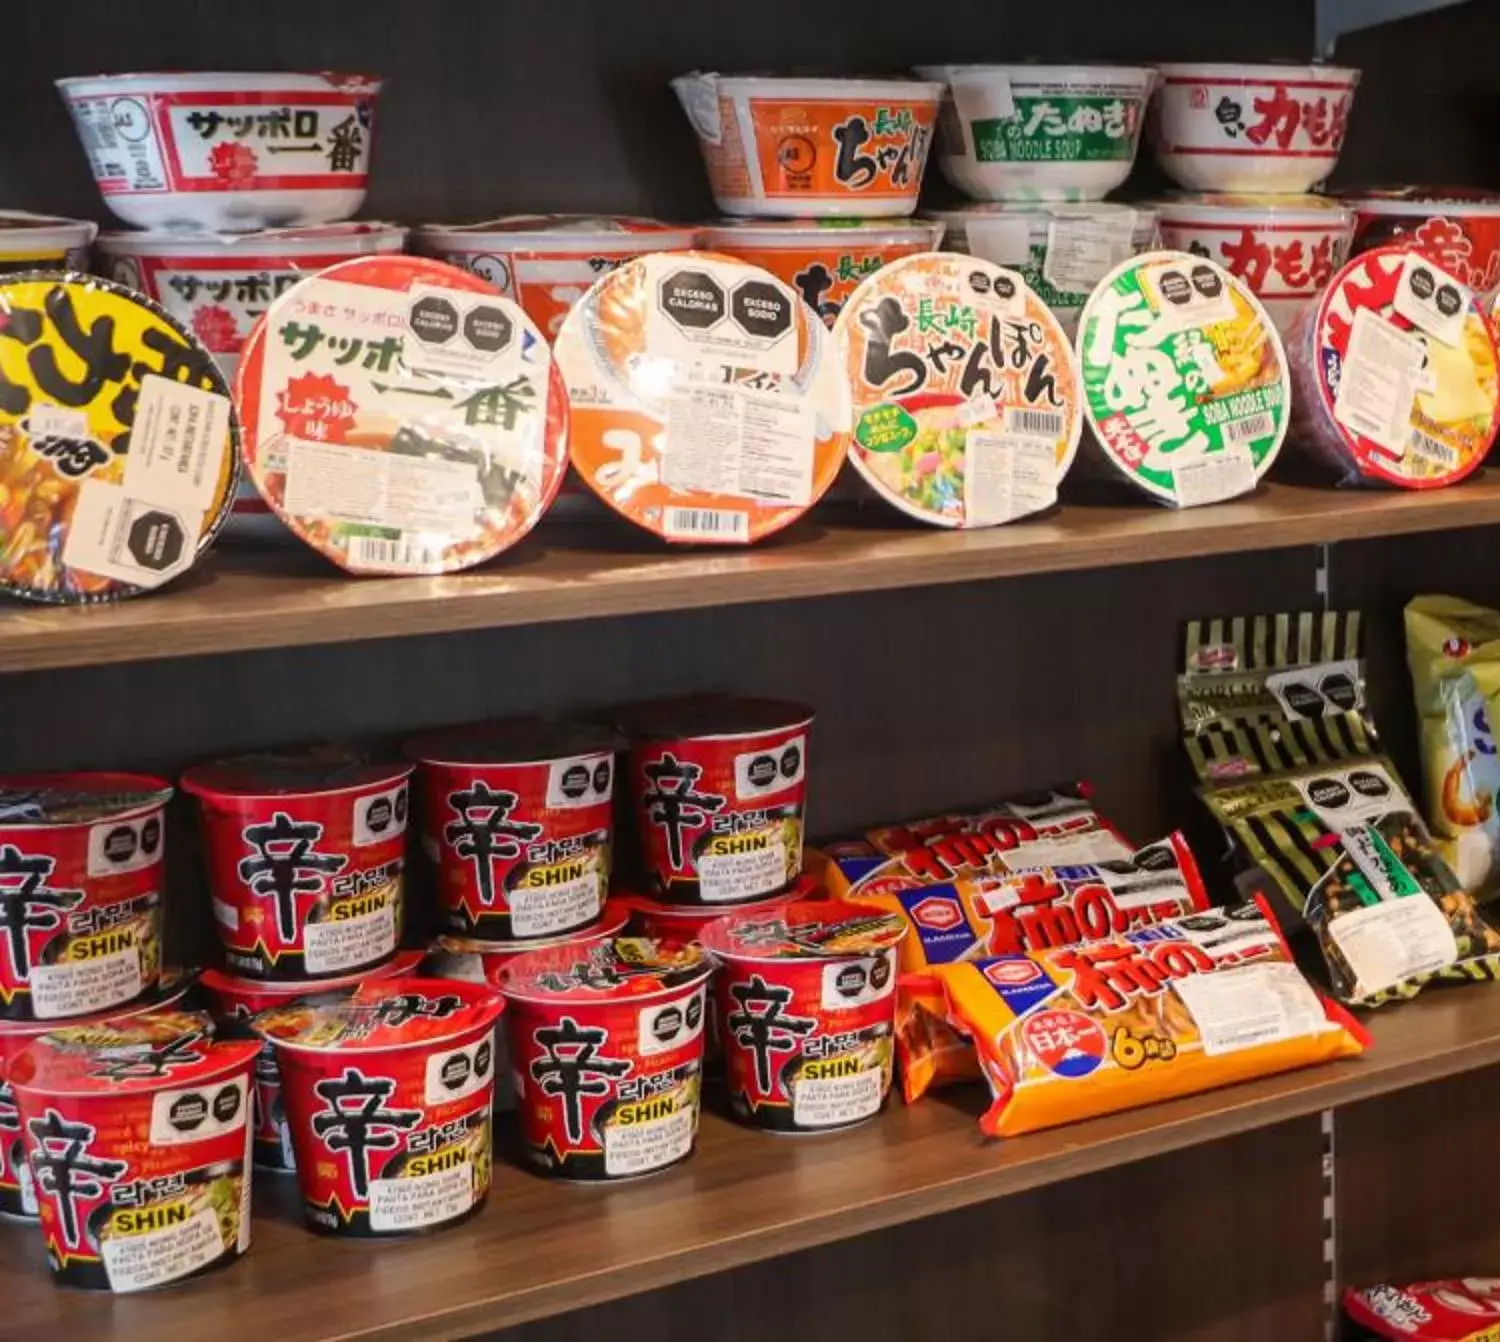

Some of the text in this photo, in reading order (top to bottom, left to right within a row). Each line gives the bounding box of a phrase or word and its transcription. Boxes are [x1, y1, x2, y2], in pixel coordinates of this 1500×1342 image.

[186, 108, 319, 140] サッポロ
[873, 107, 913, 135] 長崎
[1003, 100, 1126, 139] のたぬき
[266, 116, 362, 172] 一番
[1009, 138, 1053, 161] NOODLE
[1054, 137, 1083, 159] SOUP
[674, 287, 715, 301] EXCESO
[744, 297, 781, 312] EXCESO
[747, 307, 777, 321] SODIO
[915, 298, 980, 339] 長崎
[280, 320, 408, 373] サッポ
[859, 297, 1064, 408] ちゃんぽん
[282, 392, 354, 419] しょうゆ
[1202, 400, 1230, 425] SOBA
[642, 751, 727, 872] 辛
[443, 779, 544, 906] 辛
[715, 835, 768, 856] SHIN
[238, 812, 348, 945] 辛
[529, 865, 584, 888] SHIN
[333, 895, 386, 922] SHIN
[71, 932, 132, 960] SHIN
[726, 973, 819, 1097] 辛
[1027, 1018, 1099, 1053] 日本一
[529, 1016, 635, 1145] 辛
[804, 1059, 859, 1081] SHIN
[616, 1097, 674, 1125] SHIN
[310, 1067, 424, 1201] 辛
[408, 1148, 467, 1178] SHIN
[26, 1108, 129, 1249] 辛
[116, 1204, 187, 1233] SHIN
